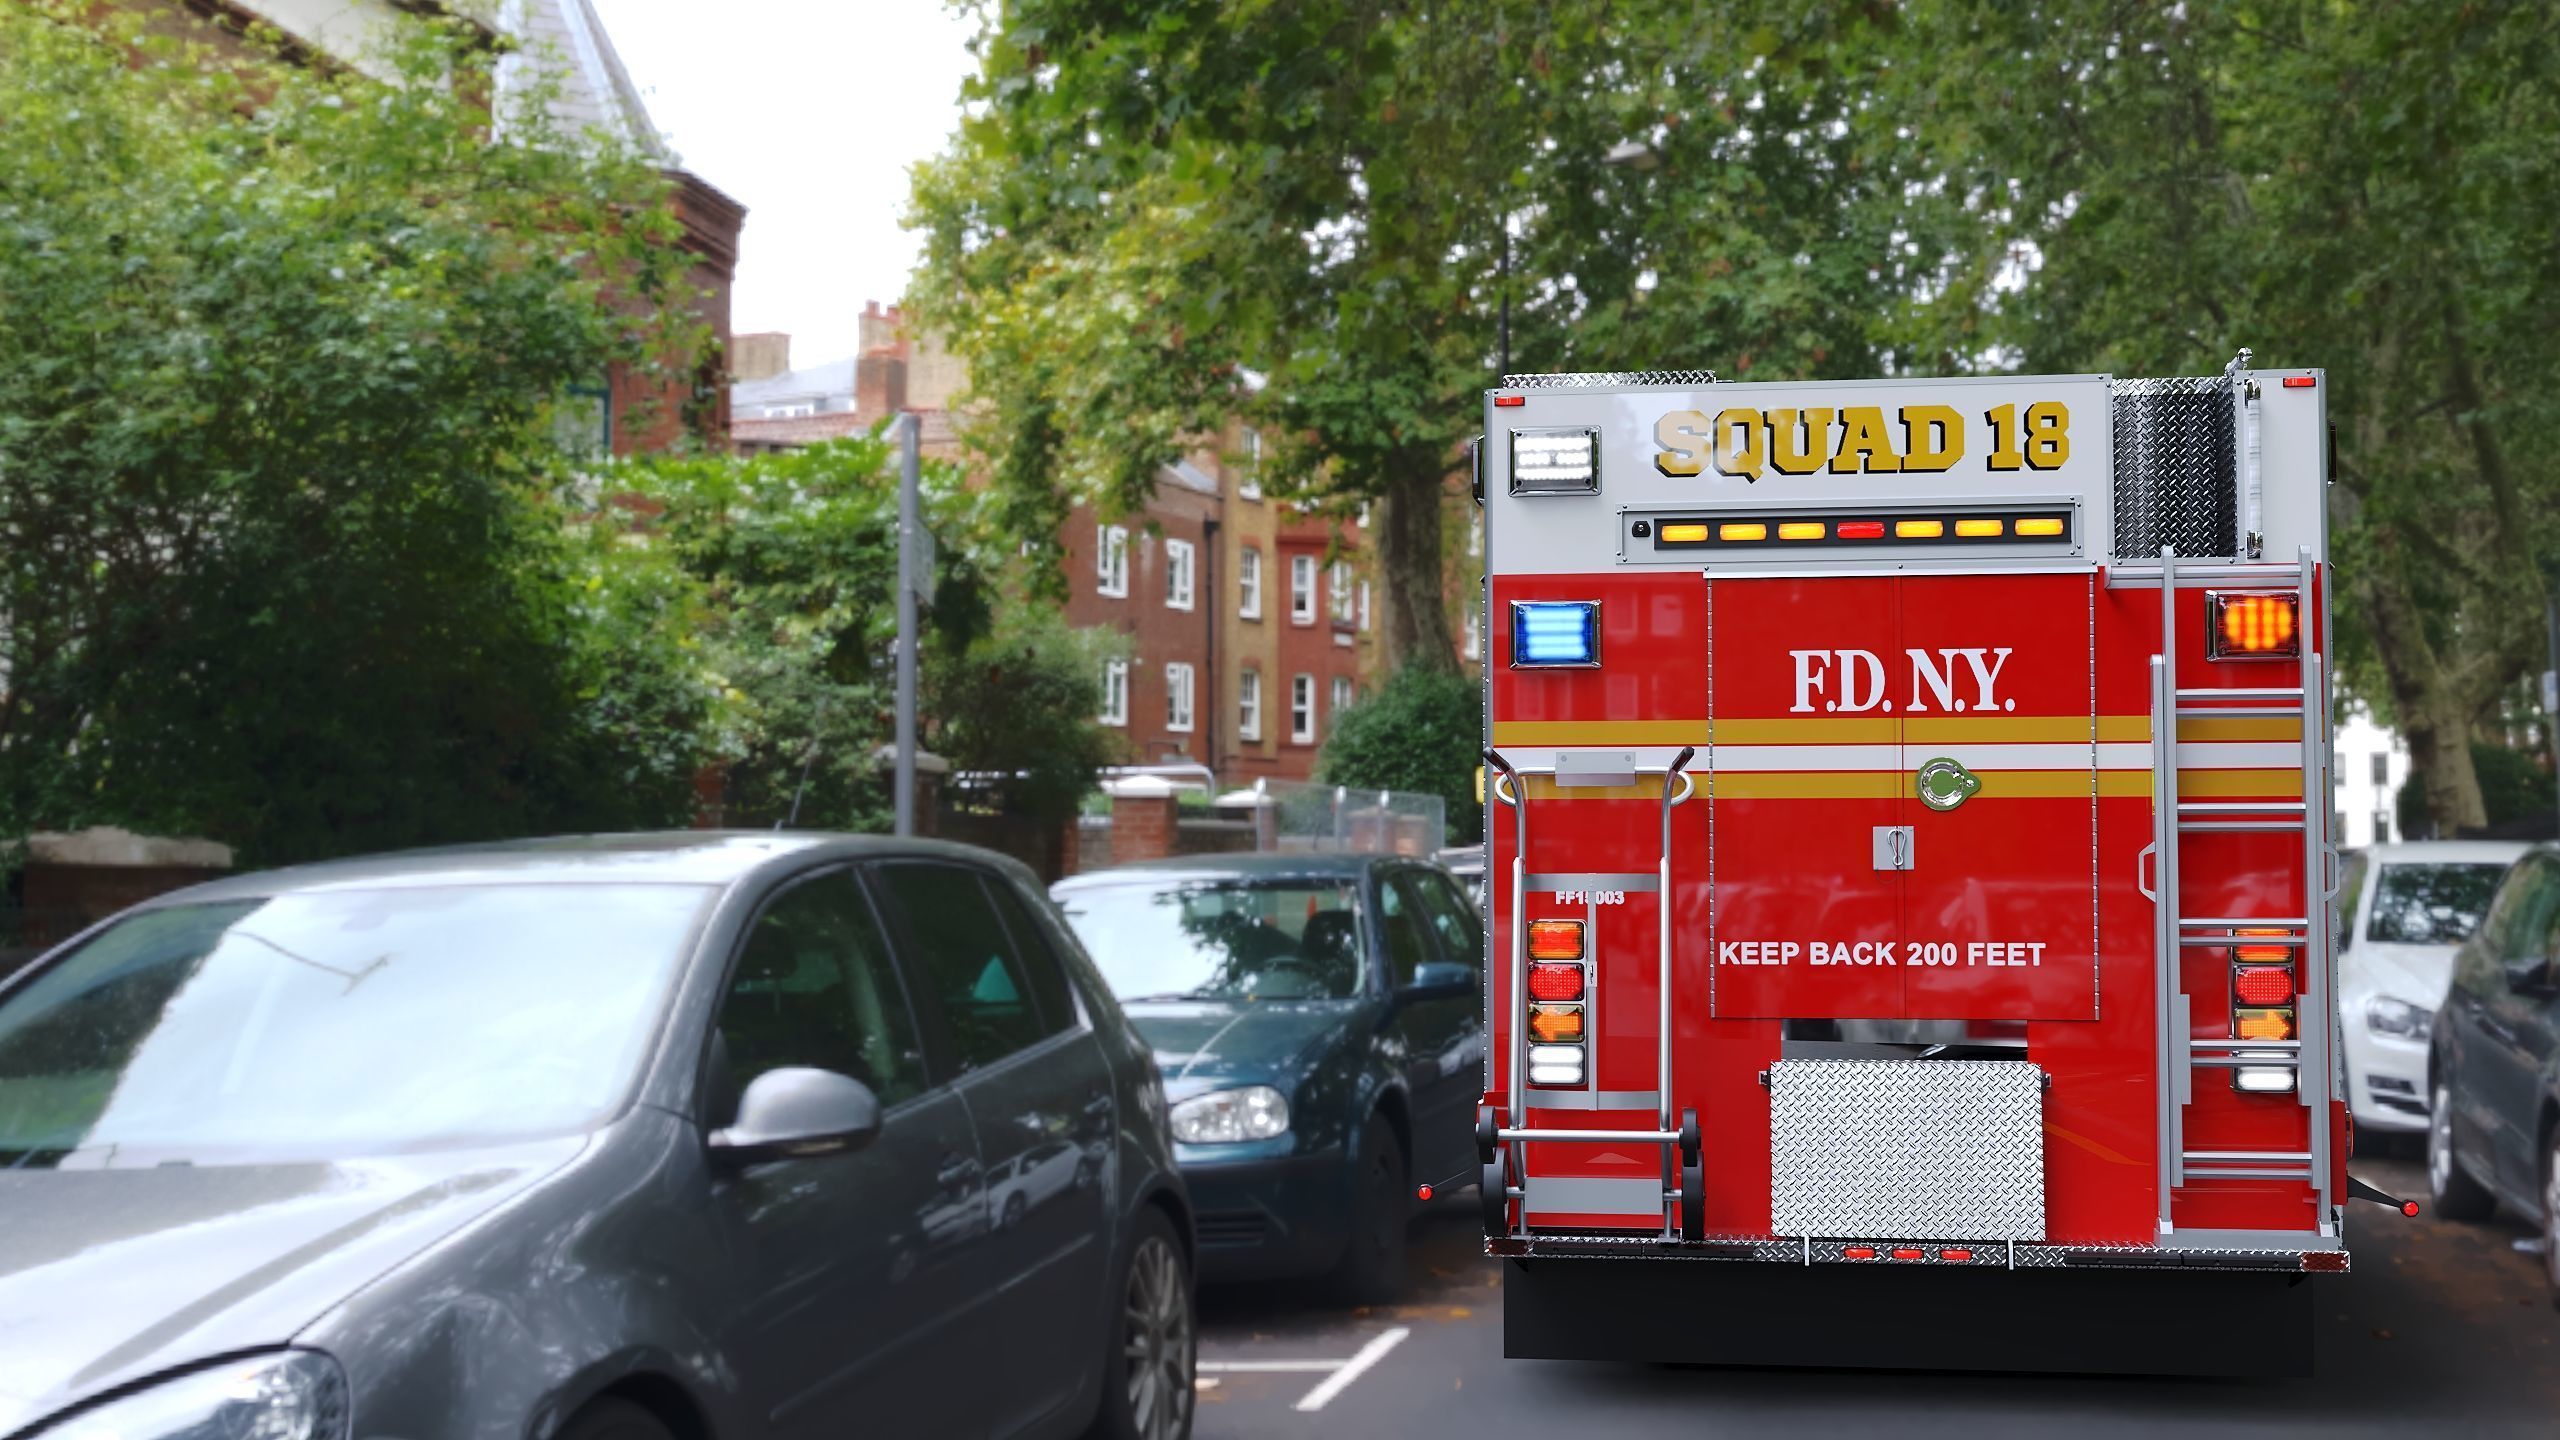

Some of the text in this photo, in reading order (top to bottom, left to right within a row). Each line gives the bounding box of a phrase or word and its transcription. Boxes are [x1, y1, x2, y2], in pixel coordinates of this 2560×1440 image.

[1653, 401, 2070, 484] SQUAD 18
[1789, 647, 2016, 712] F.D. N.Y.
[1719, 941, 2047, 967] KEEP BACK 200 FEET
